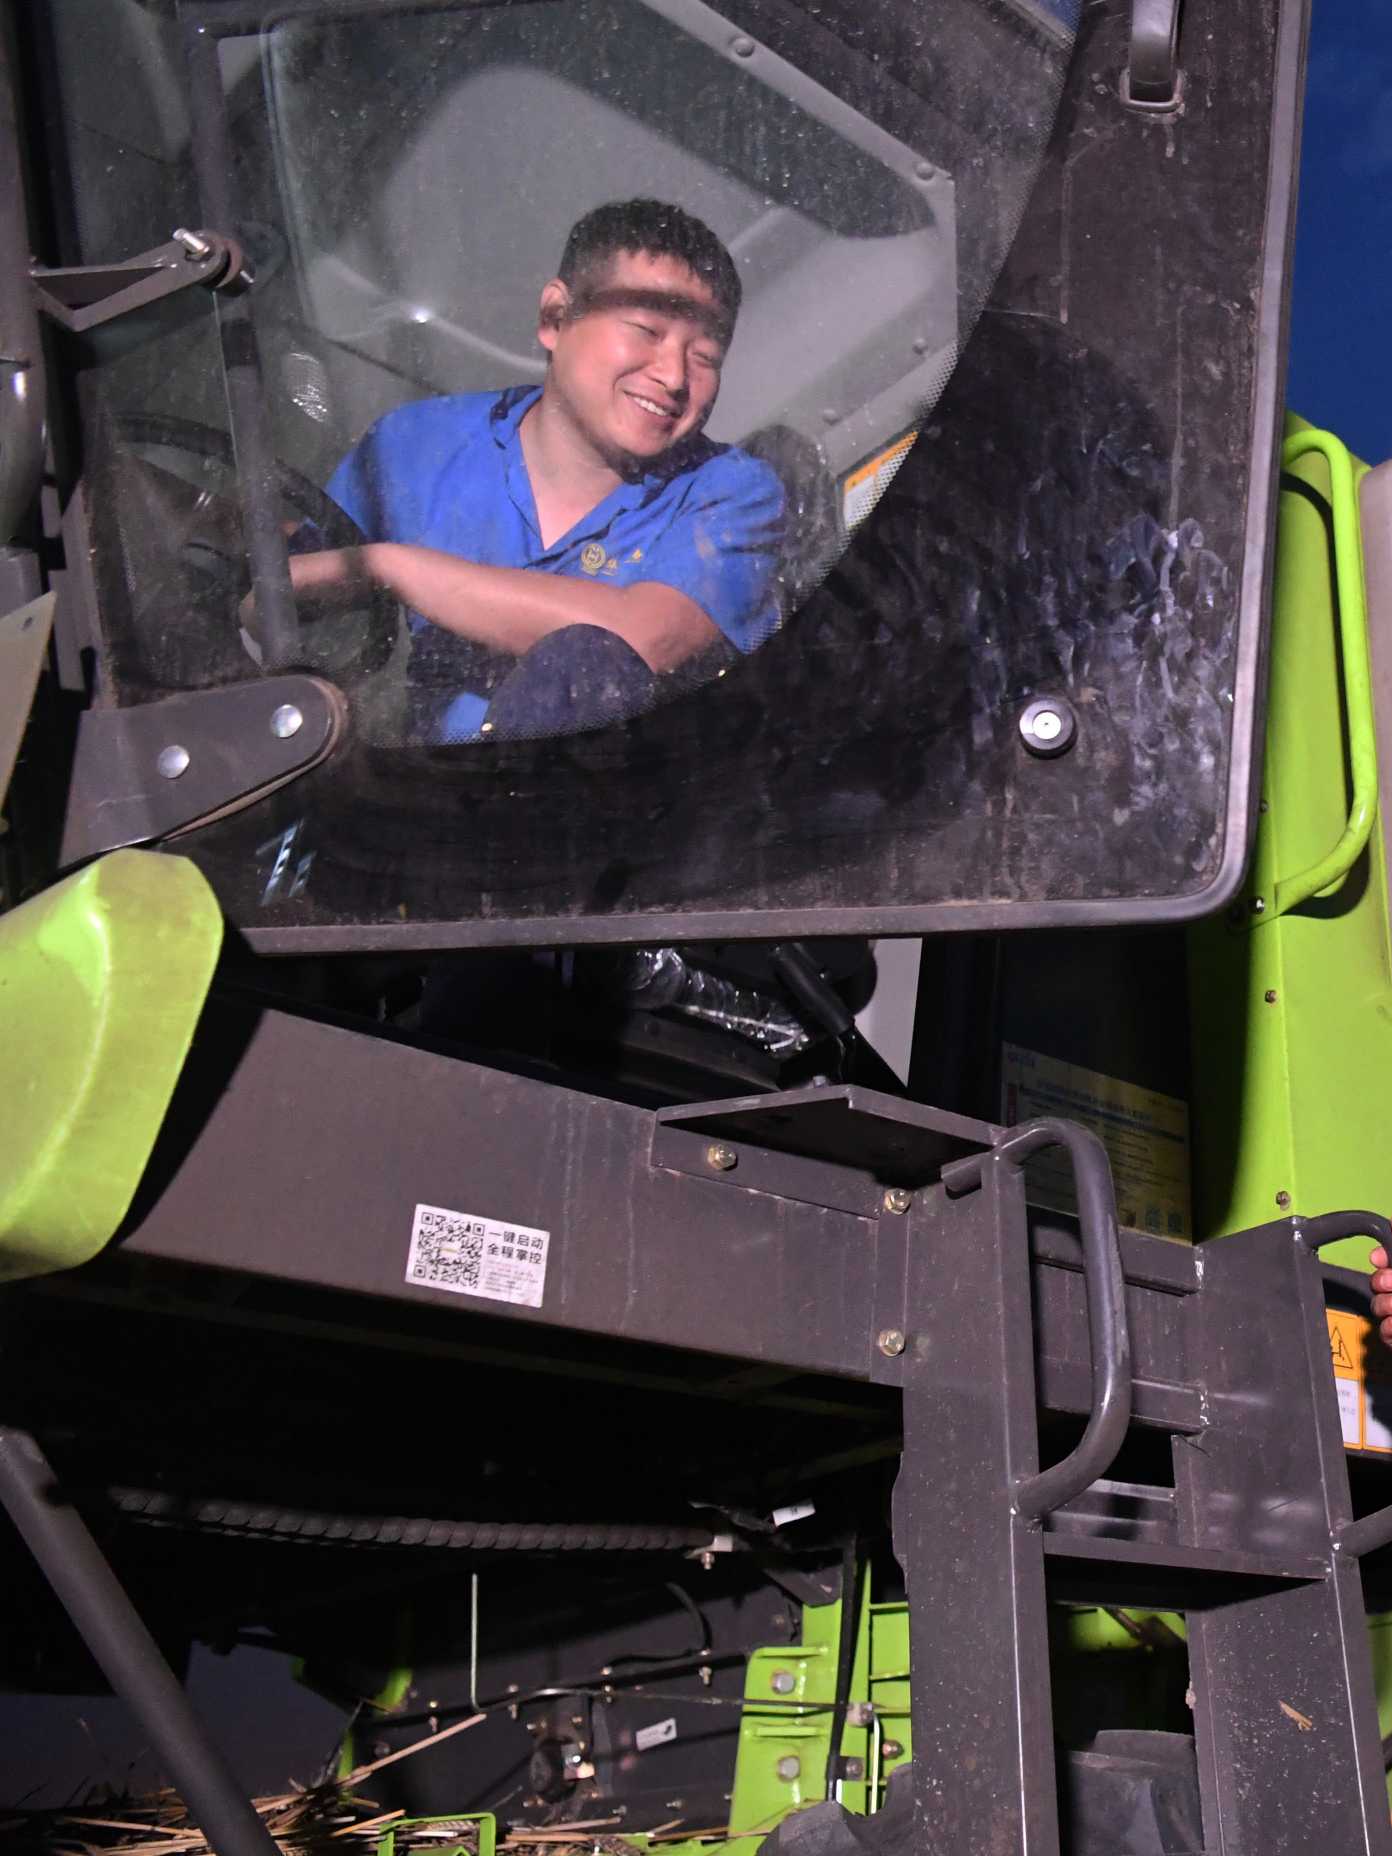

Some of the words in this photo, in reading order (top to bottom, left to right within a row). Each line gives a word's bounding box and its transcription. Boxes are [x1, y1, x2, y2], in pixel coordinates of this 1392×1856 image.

[488, 1231, 544, 1250] 一键启动
[487, 1243, 542, 1264] 全程掌控
